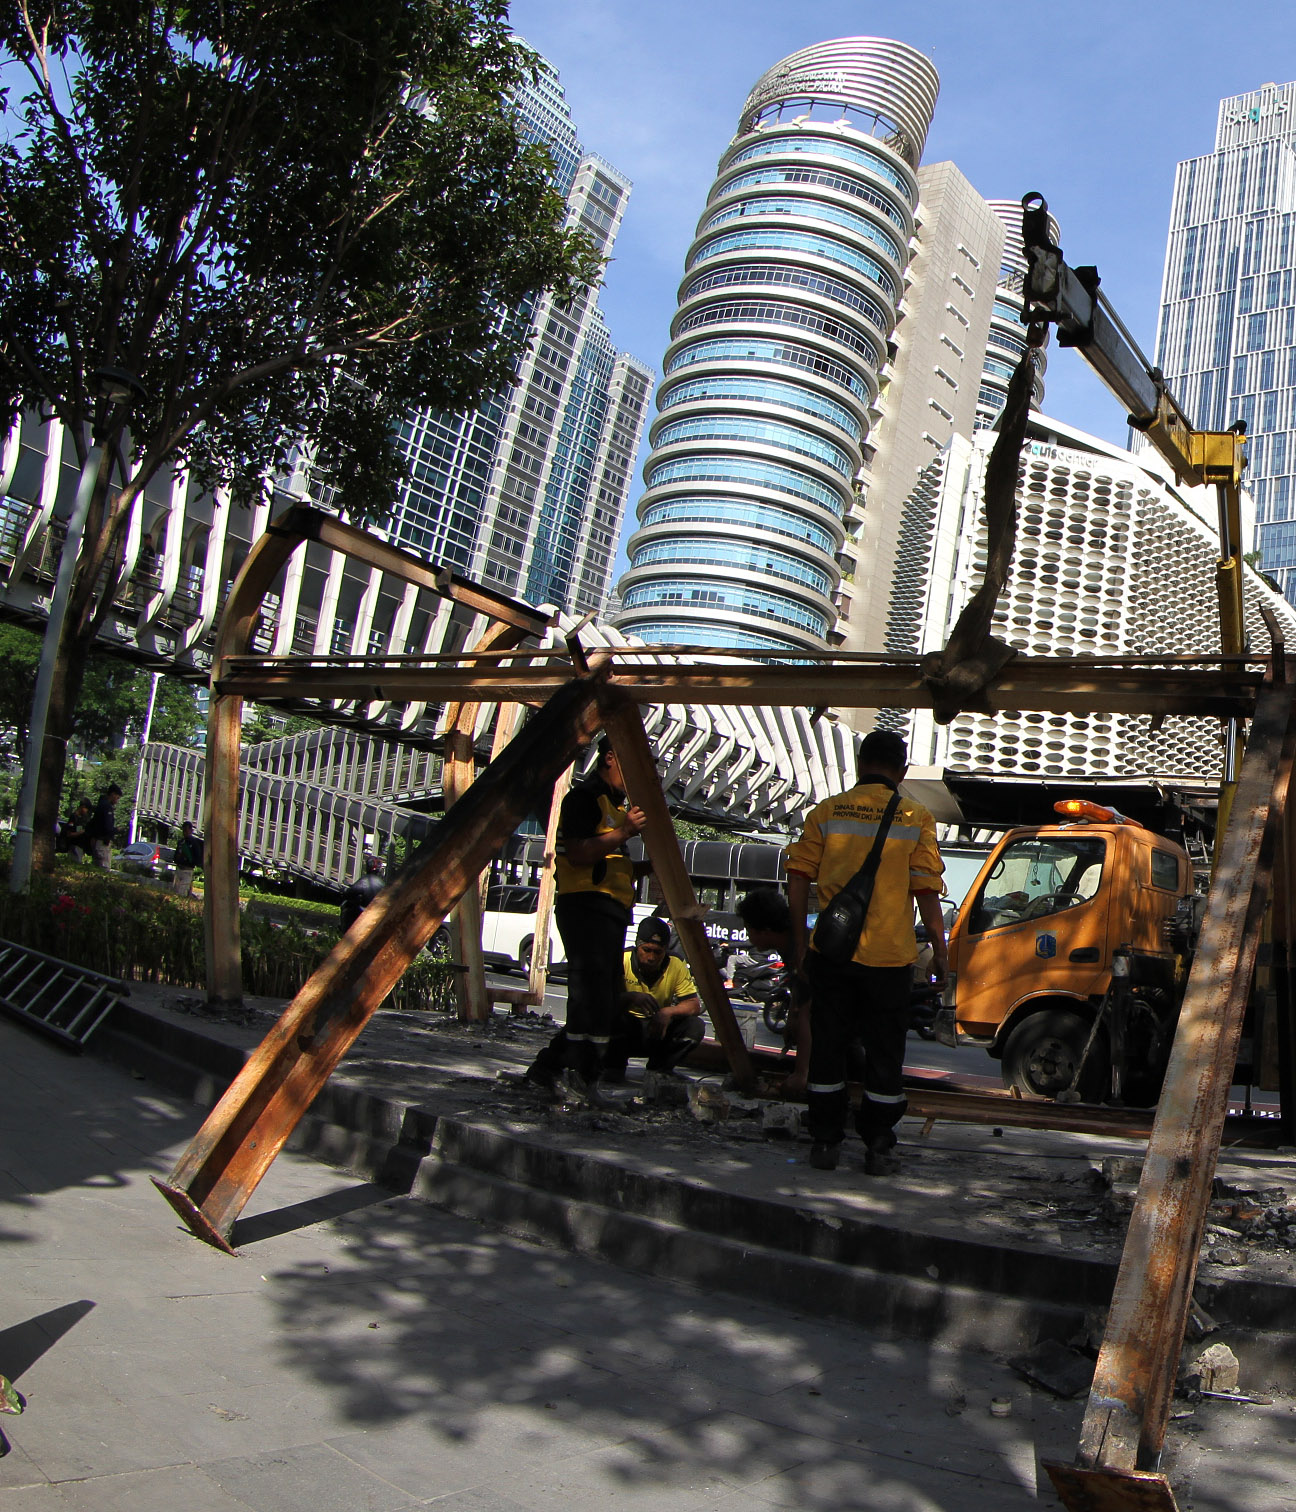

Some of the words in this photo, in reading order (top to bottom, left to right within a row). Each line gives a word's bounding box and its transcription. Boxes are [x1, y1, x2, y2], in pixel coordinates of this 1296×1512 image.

[1226, 99, 1289, 125] Sequis
[857, 805, 874, 813] BINA
[861, 813, 872, 821] DKI
[703, 922, 729, 939] alte
